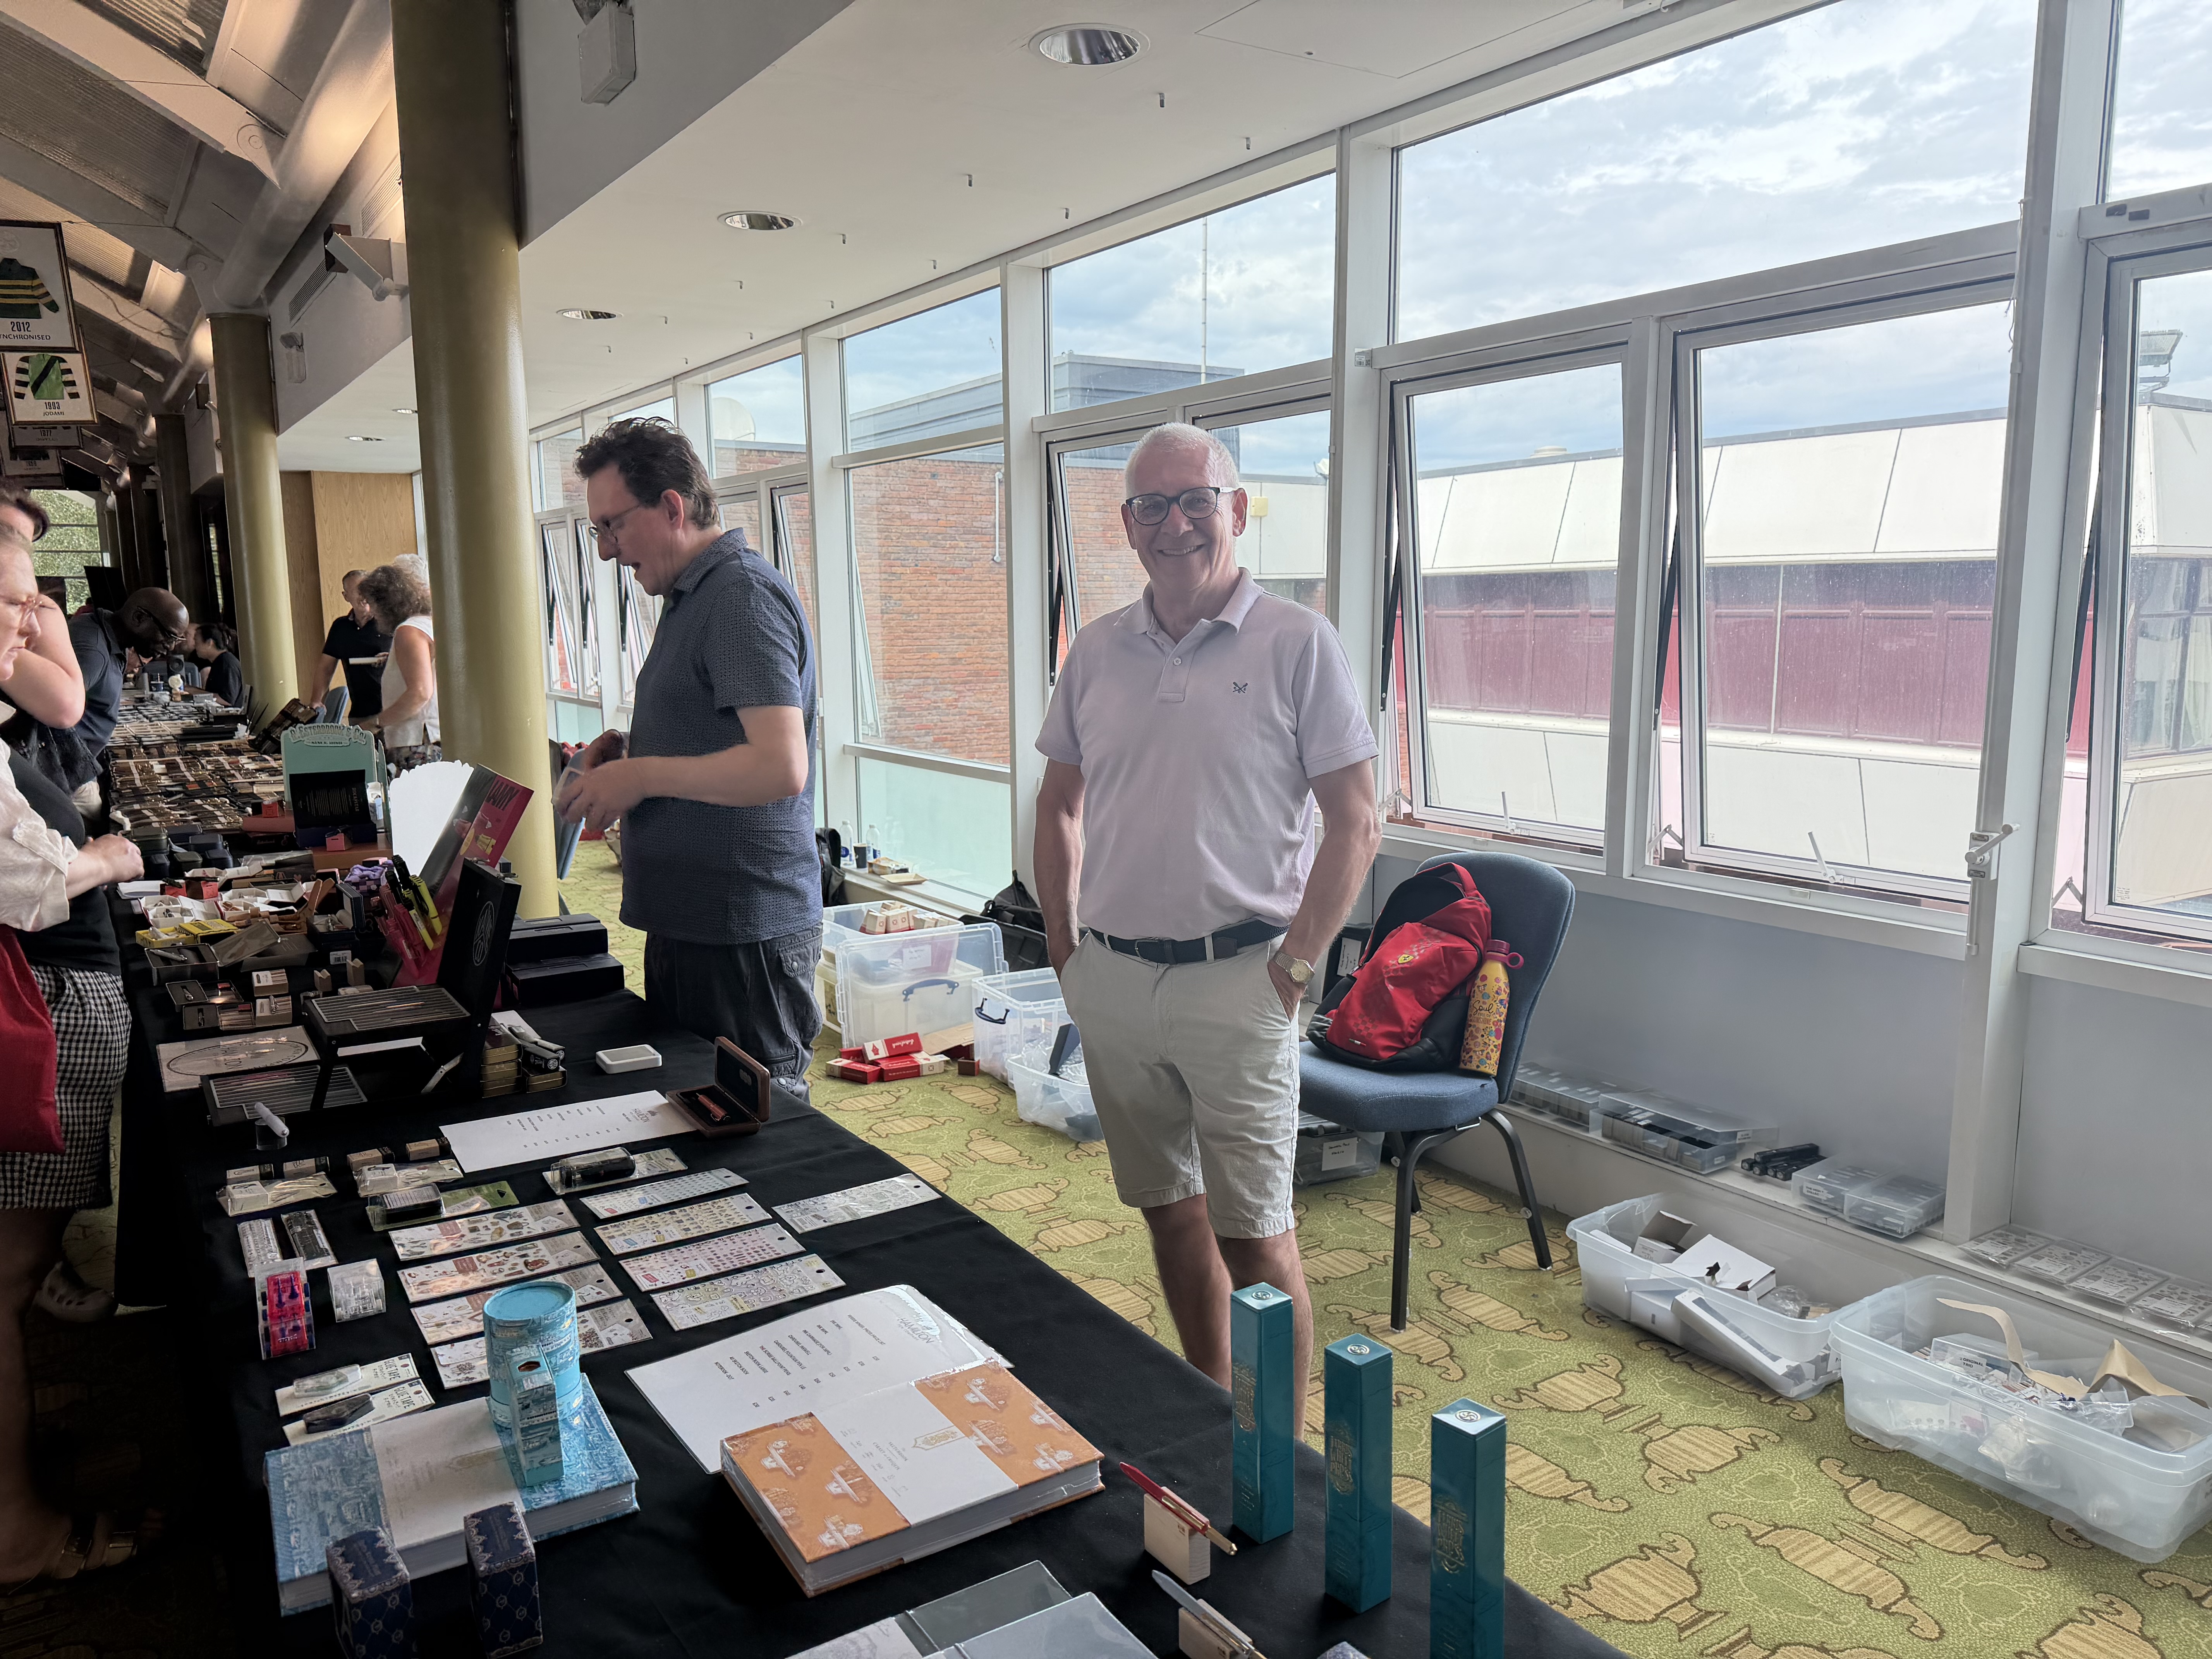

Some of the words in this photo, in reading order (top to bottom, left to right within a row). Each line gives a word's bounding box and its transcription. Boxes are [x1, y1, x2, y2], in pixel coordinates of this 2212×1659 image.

[10, 321, 31, 332] 2012
[485, 780, 520, 811] LAMY
[1472, 1000, 1493, 1015] Soul
[897, 1318, 934, 1344] HAMILTON
[773, 1340, 788, 1351] CAROUSEL
[784, 1350, 799, 1362] FOUNTAIN
[787, 1334, 802, 1346] CAROUSEL
[798, 1345, 812, 1355] INKWELL
[384, 1359, 397, 1369] GLUE
[732, 1359, 744, 1368] SKETCH
[743, 1351, 756, 1360] SKETCH
[758, 1365, 769, 1373] LARGE
[763, 1350, 774, 1358] SCRIBE
[770, 1357, 786, 1369] BALLPOINT
[1963, 1358, 1984, 1367] ORIGINAL
[387, 1368, 400, 1380] TAPE
[713, 1361, 728, 1374] NOTEBOOK
[394, 1386, 409, 1398] GLUE
[400, 1396, 415, 1409] TAPE
